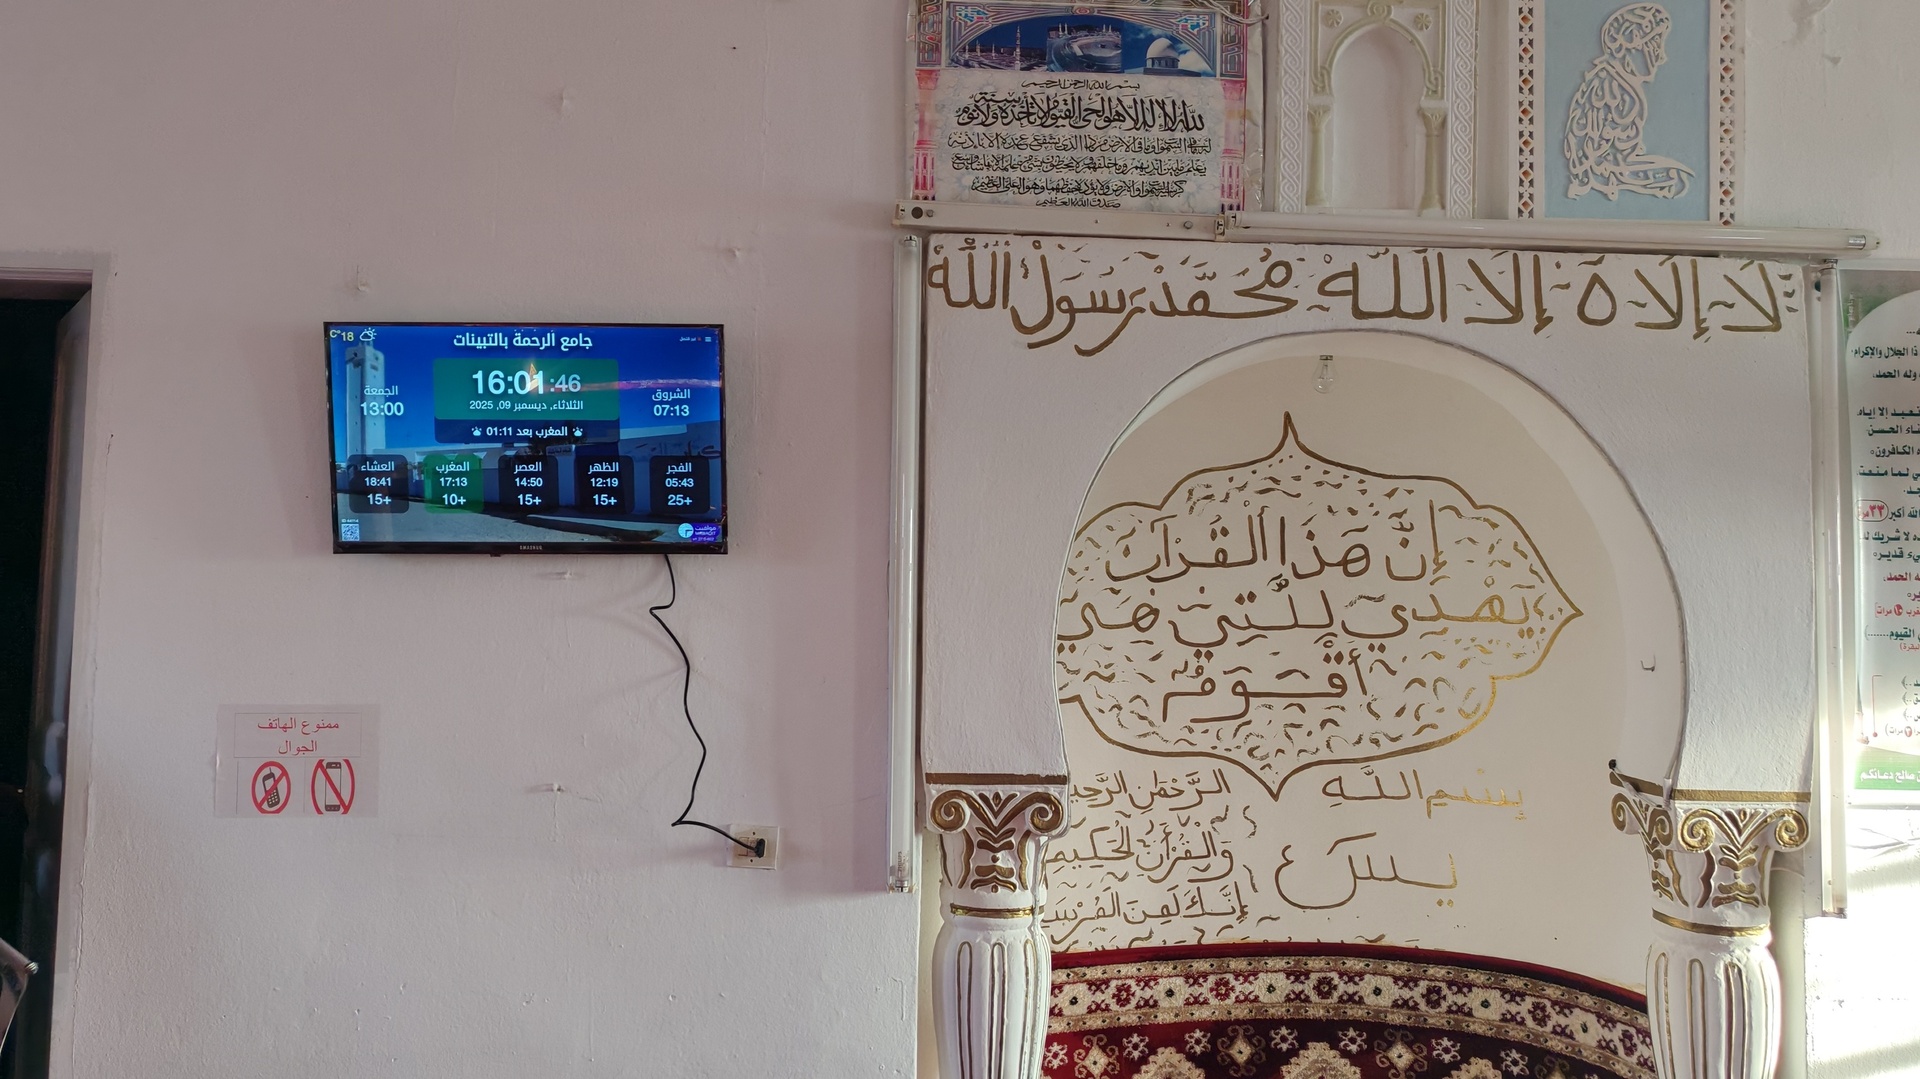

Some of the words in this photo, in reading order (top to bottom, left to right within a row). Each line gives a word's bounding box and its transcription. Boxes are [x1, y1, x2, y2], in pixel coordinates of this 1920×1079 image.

[927, 236, 1011, 310] الله
[1149, 247, 1300, 318] محمد
[1317, 247, 1449, 322] الله
[1010, 241, 1148, 357] رسول
[453, 332, 508, 349] بالتبينات
[513, 331, 556, 350] الرحمة
[560, 333, 593, 351] جامع
[1884, 346, 1909, 358] الجلال
[1903, 369, 1917, 381] وله
[363, 385, 399, 397] الجمعة
[652, 387, 690, 401] الشروق
[360, 401, 404, 416] 13:00
[469, 400, 494, 410] 2025
[513, 401, 547, 412] ديسمبر
[653, 404, 690, 416] 07:13
[486, 426, 513, 436] 01:11
[516, 427, 533, 438] بعد
[535, 426, 568, 438] المغرب
[360, 460, 395, 472] العشاء
[435, 461, 470, 473] المغرب
[513, 461, 542, 474] العصر
[588, 461, 620, 474] الظهر
[666, 462, 692, 474] الفجر
[1891, 467, 1909, 477] لما
[364, 477, 392, 487] 18:41
[439, 477, 468, 487] 17:13
[515, 477, 543, 488] 14:50
[590, 477, 619, 488] 12:19
[665, 478, 694, 488] 05:43
[1888, 506, 1905, 521] أكبر
[1871, 529, 1901, 544] شريك
[1903, 530, 1910, 542] لا
[257, 717, 297, 733] الهاتف
[301, 719, 340, 735] ممنوع
[278, 740, 318, 756] الجوال
[1069, 770, 1129, 807] الرحي
[1128, 768, 1231, 812] الرحمن
[1321, 766, 1423, 808] الله
